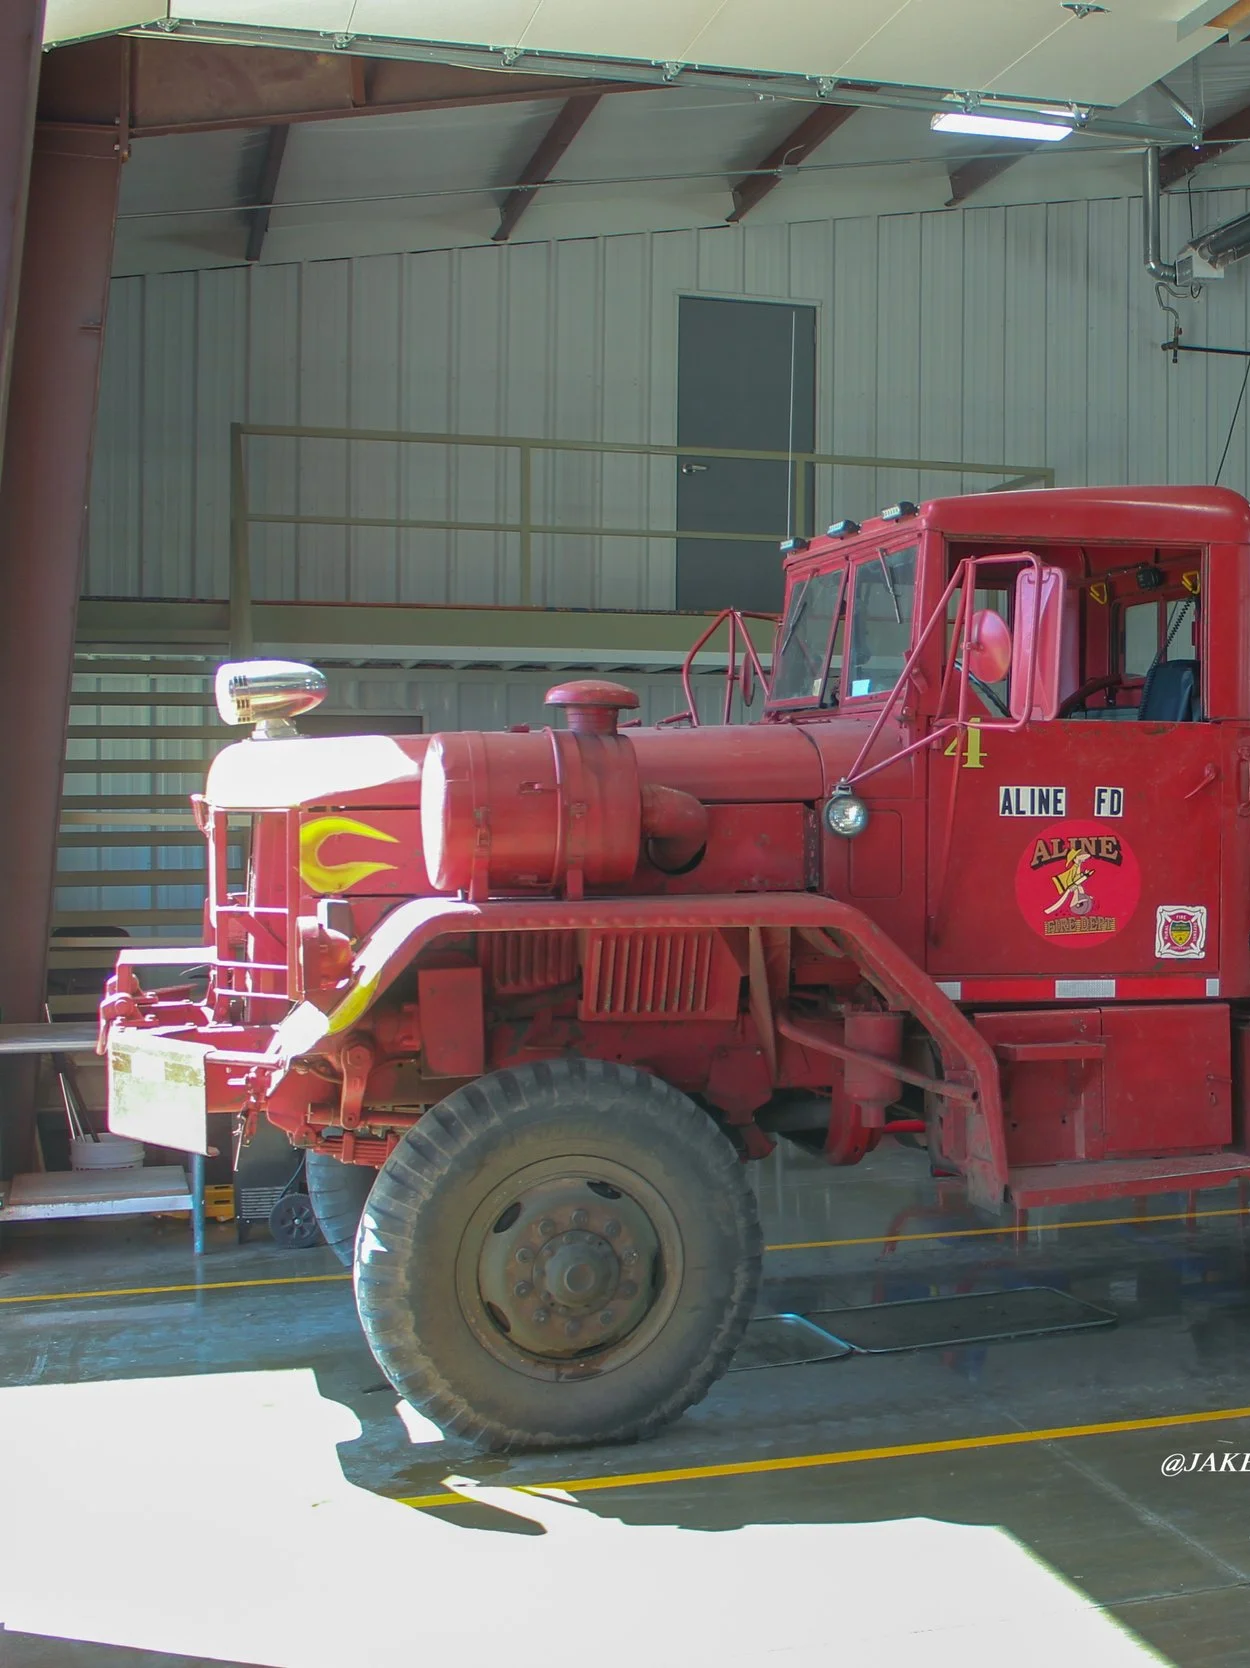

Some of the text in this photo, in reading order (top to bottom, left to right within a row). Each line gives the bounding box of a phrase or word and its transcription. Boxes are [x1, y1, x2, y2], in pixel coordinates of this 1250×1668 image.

[944, 717, 988, 768] 4
[1000, 787, 1122, 815] ALINE FD
[1031, 836, 1122, 869] ALINE
[1047, 916, 1114, 933] FIRE DEPT
